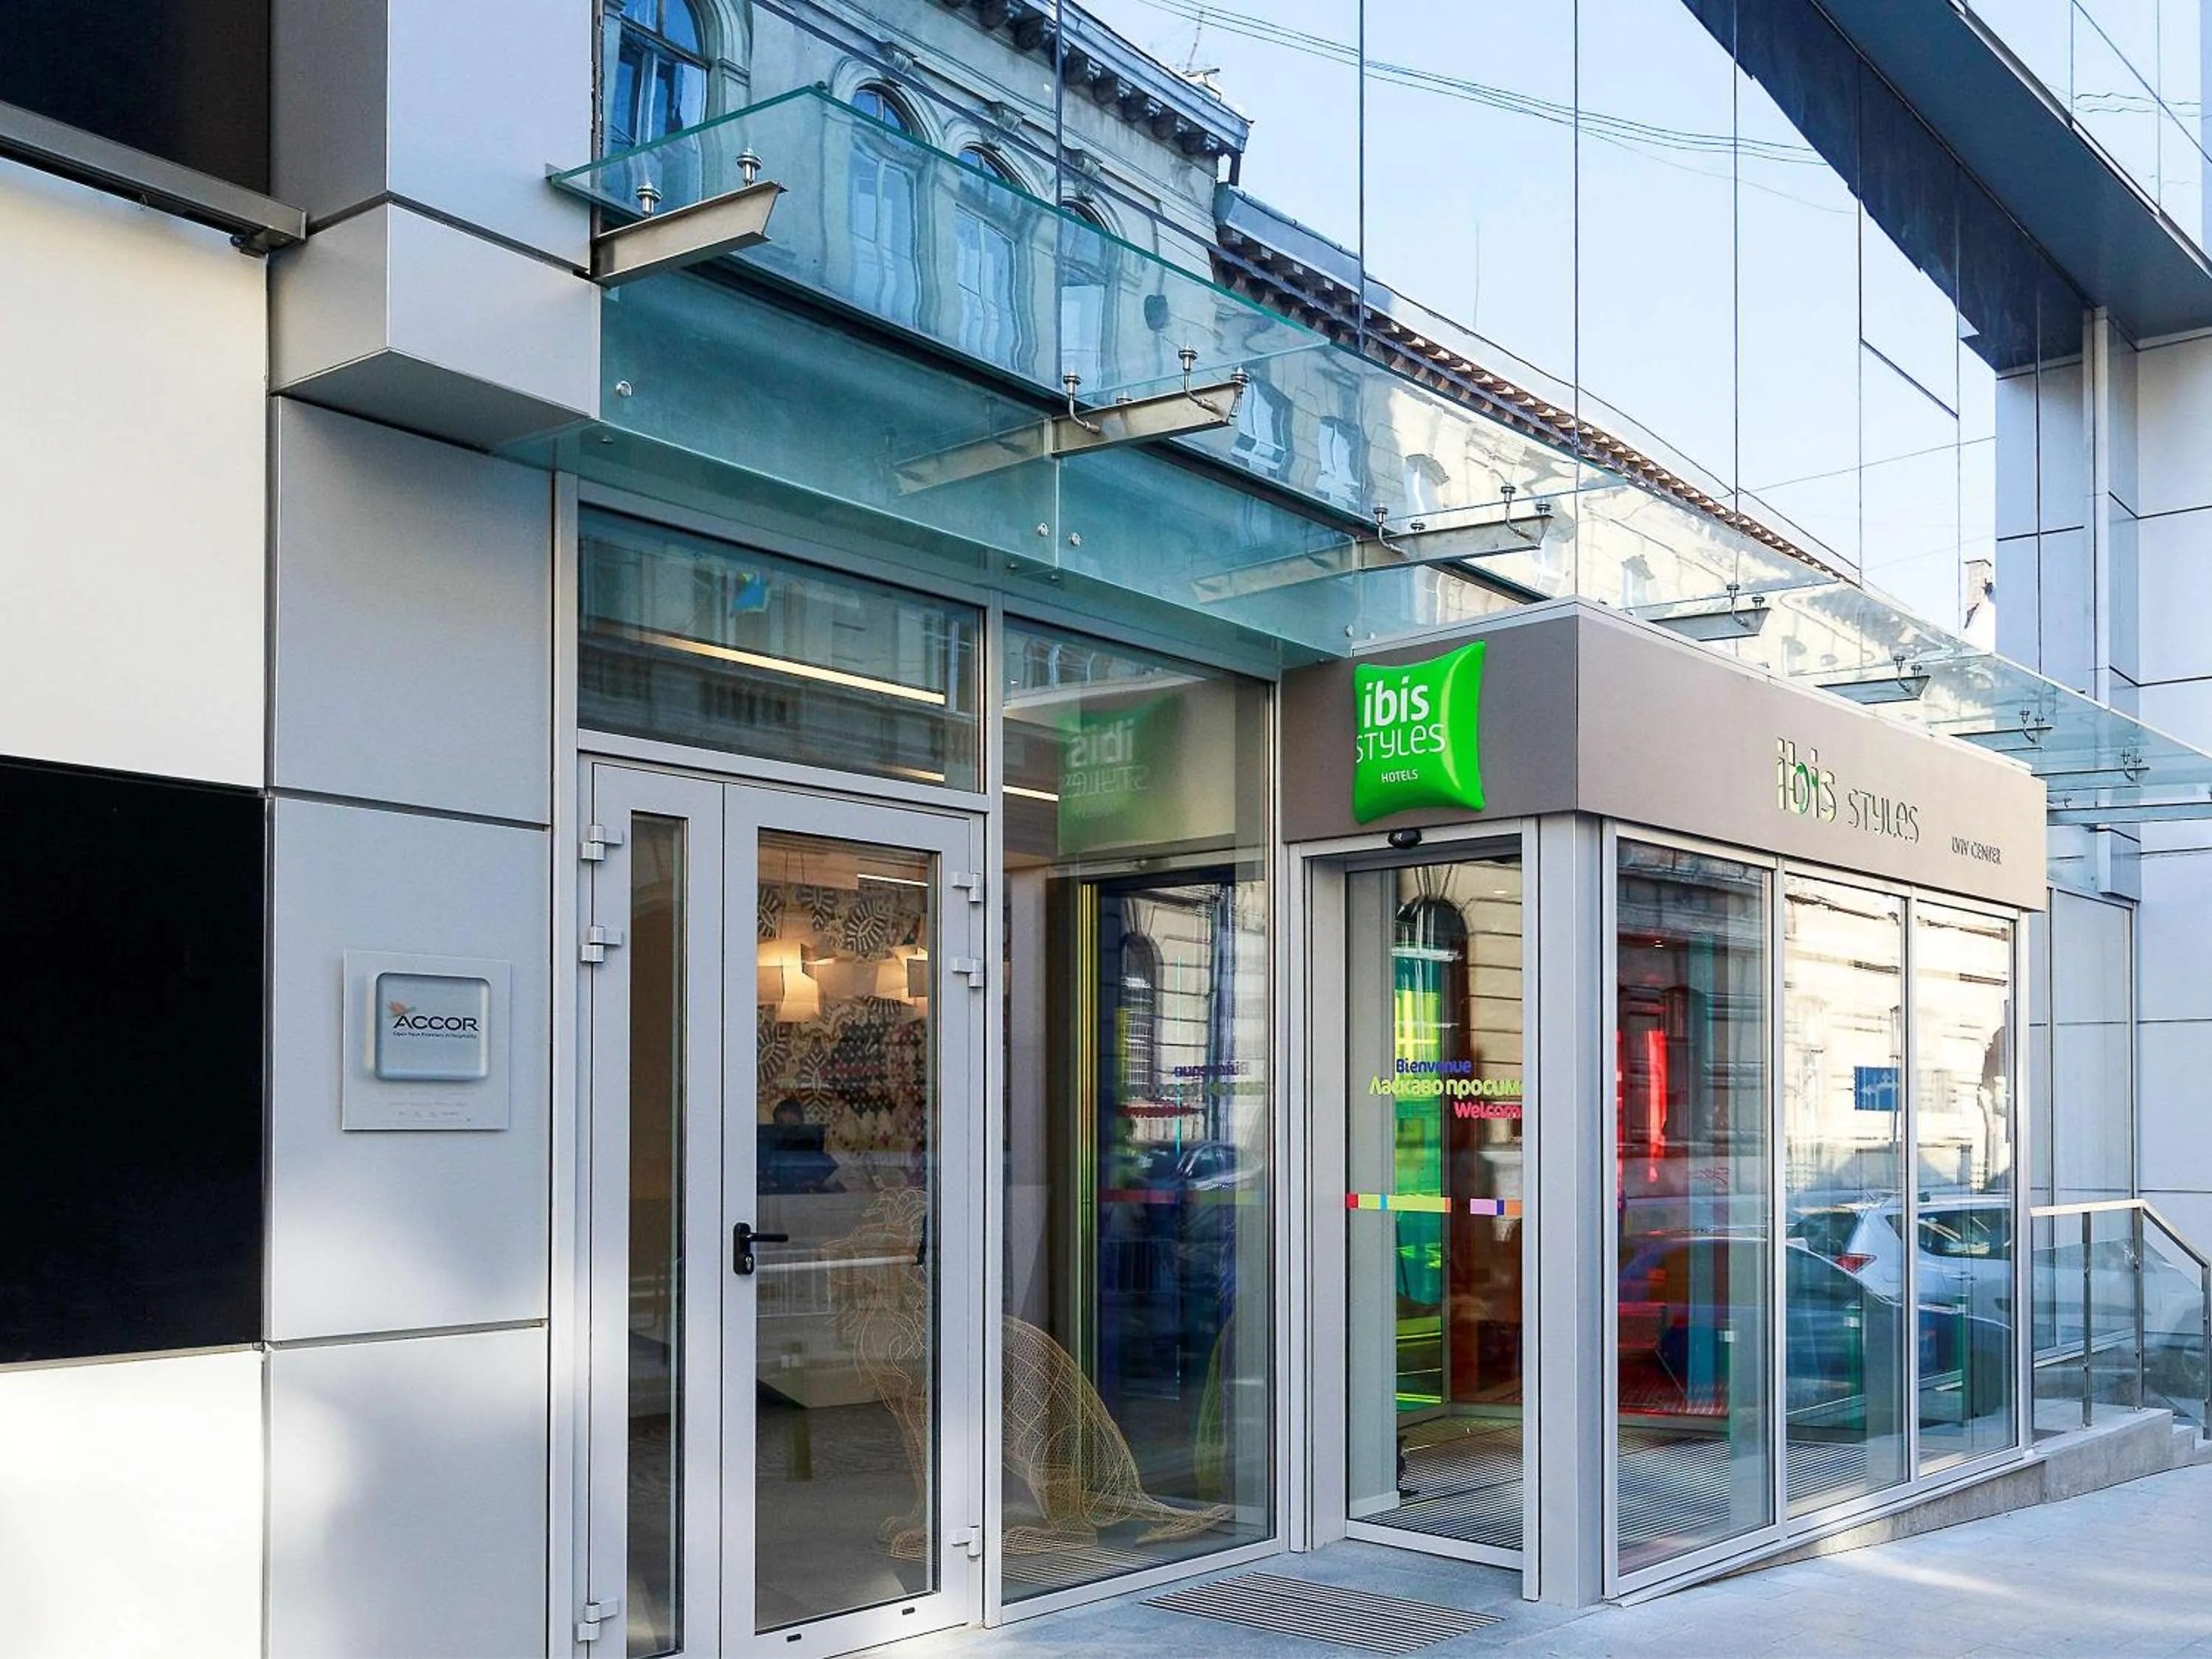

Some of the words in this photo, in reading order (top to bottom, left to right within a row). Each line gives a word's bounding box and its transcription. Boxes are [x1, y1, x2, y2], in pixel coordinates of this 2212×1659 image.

[1363, 675, 1430, 728] ibis
[1381, 769, 1419, 784] HOTELS
[1777, 737, 1837, 823] ibis
[1970, 841, 2002, 865] CENTER
[393, 1015, 479, 1032] ACCOR
[1396, 1058, 1473, 1074] Bienvenue
[1368, 1076, 1444, 1096] Ласкаво
[1445, 1079, 1522, 1099] просим
[1454, 1102, 1522, 1119] Welcom
